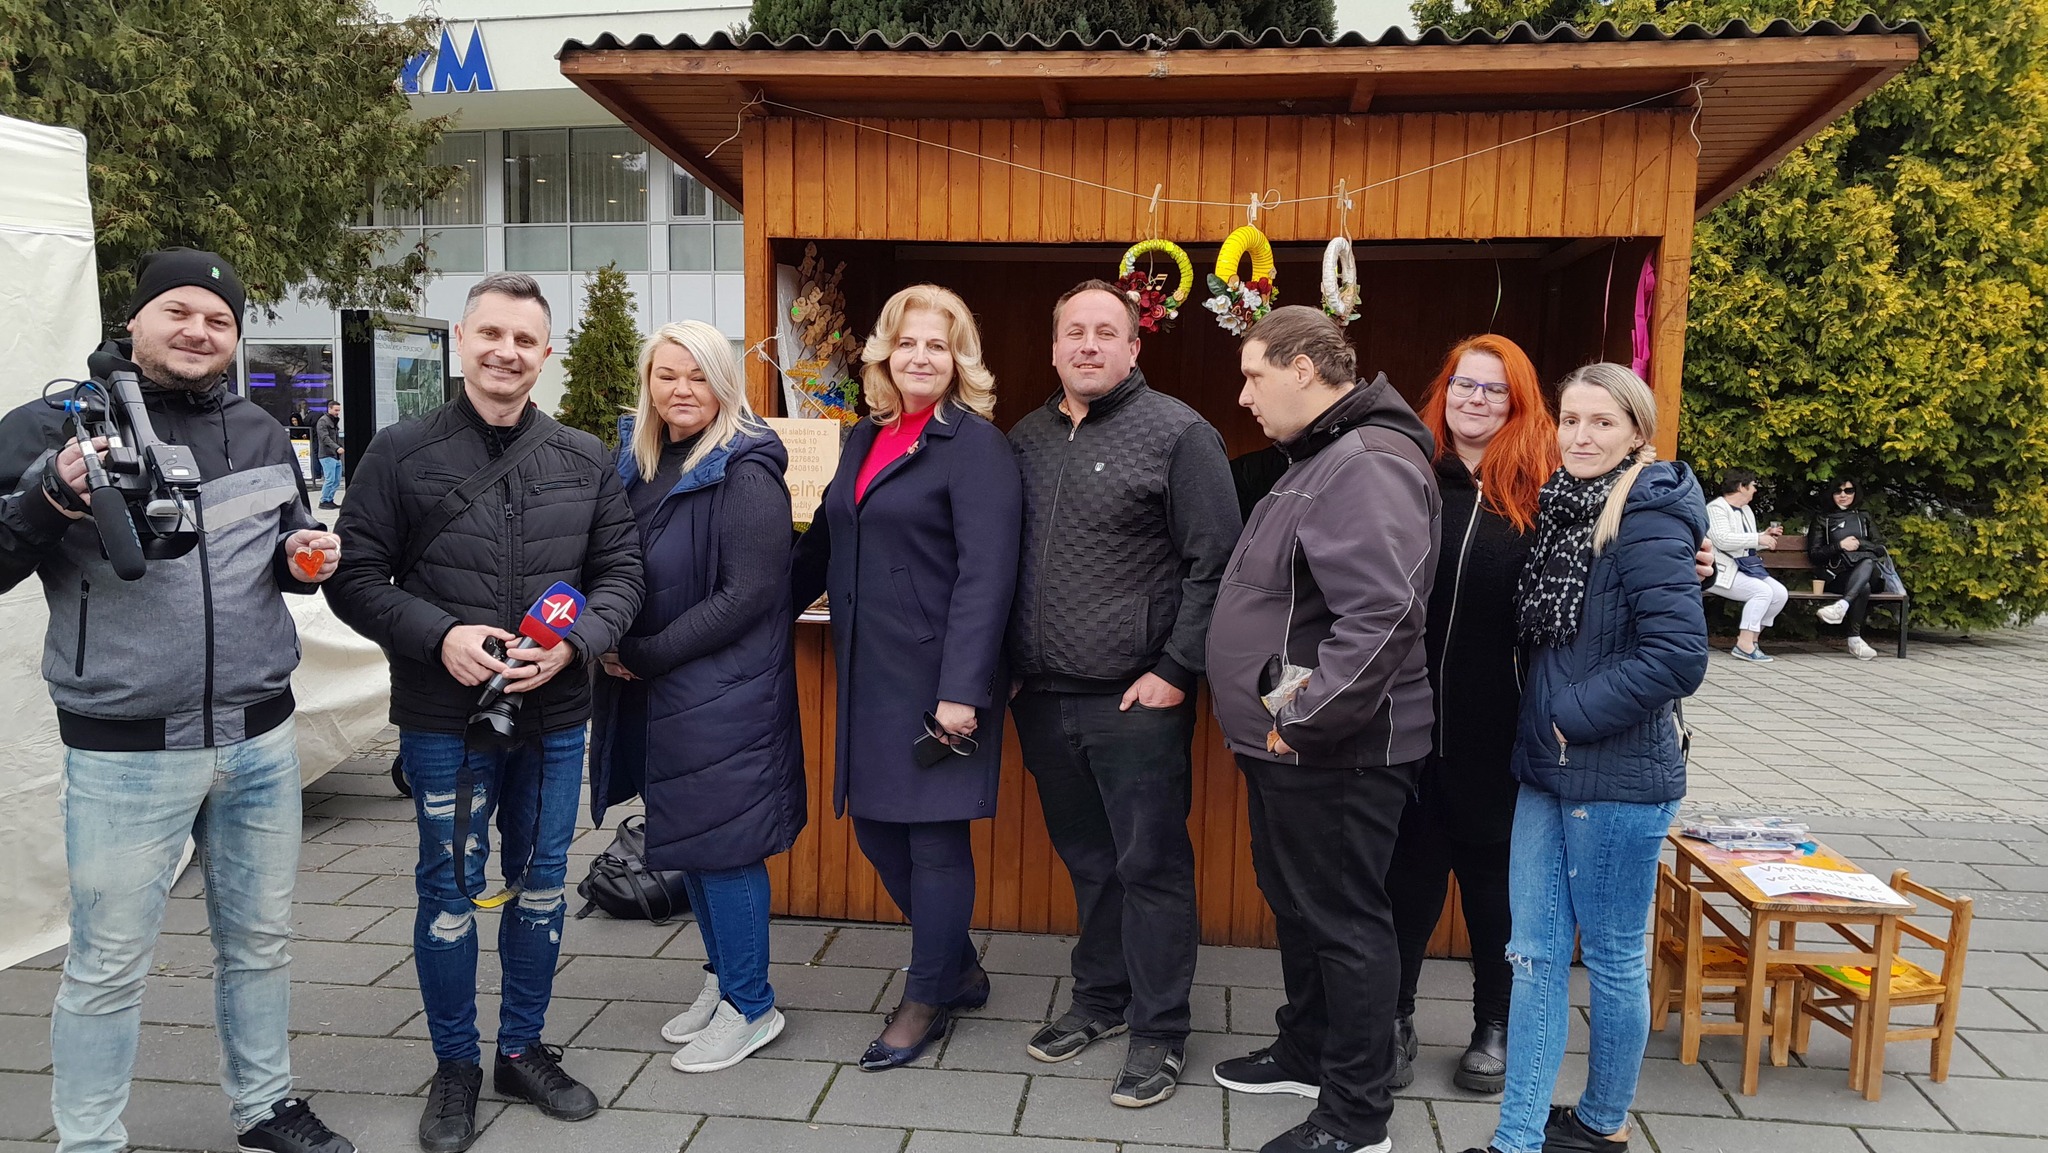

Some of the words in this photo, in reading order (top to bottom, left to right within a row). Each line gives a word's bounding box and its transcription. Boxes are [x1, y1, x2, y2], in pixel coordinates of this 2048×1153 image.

[788, 464, 823, 472] 24081961
[786, 479, 825, 498] elňa
[792, 500, 812, 511] užitý
